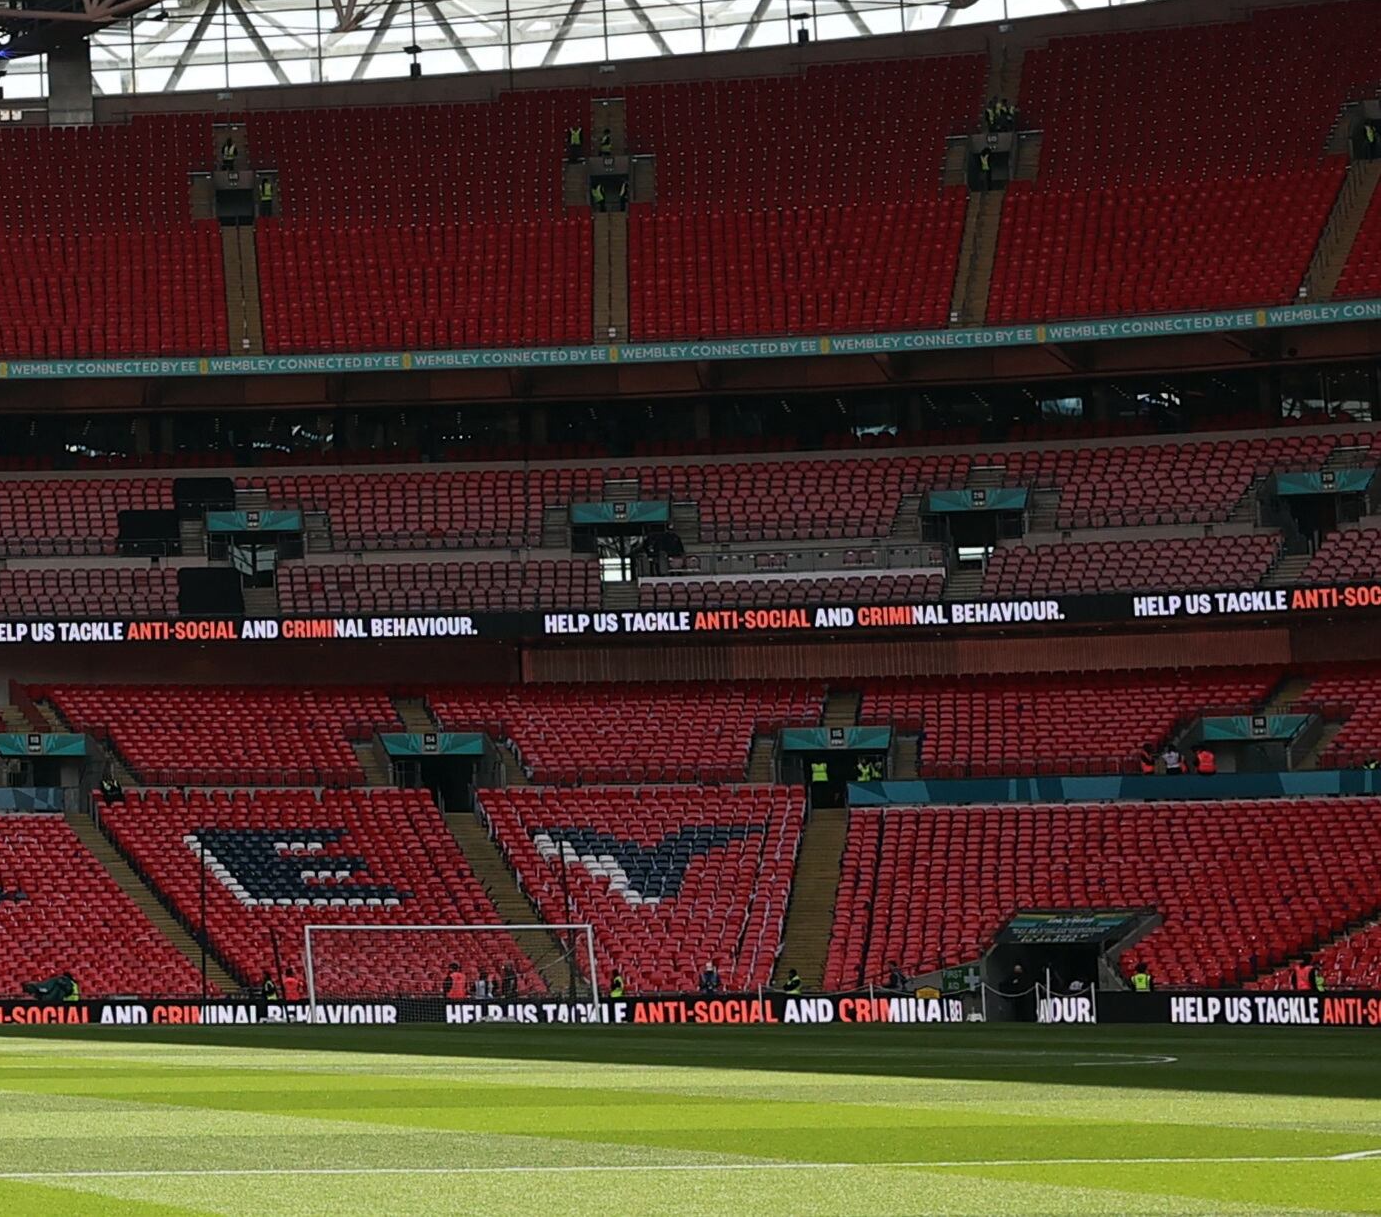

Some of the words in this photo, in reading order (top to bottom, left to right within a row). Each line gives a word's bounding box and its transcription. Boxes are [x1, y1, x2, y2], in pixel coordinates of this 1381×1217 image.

[1050, 323, 1116, 339] WEMBLEY
[1122, 317, 1212, 334] CONNECTED
[1215, 315, 1233, 327] BY
[1237, 314, 1252, 325] EE
[833, 337, 899, 350] WEMBLEY
[905, 332, 993, 346] CONNECTED
[995, 330, 1013, 342] BY
[1017, 329, 1032, 341] EE
[1134, 596, 1181, 616] HELP
[1186, 594, 1211, 614] US
[1215, 591, 1287, 612] TACKLE
[31, 623, 54, 641] US
[58, 622, 123, 641] TACKLE
[128, 622, 237, 639] ANTI-SOCIAL
[242, 621, 278, 638] AND
[282, 620, 367, 638] CRIMINAL
[371, 617, 477, 636] BEHAVIOUR.
[545, 614, 589, 633] HELP
[594, 613, 618, 632] US
[622, 611, 690, 632] TACKLE
[695, 609, 810, 629] ANTI-SOCIAL
[815, 607, 853, 627] AND
[858, 605, 948, 626] CRIMINAL
[952, 601, 1064, 623] BEHAVIOUR.
[101, 1006, 147, 1023] AND
[446, 1005, 503, 1023] HELP
[509, 1005, 538, 1023] US
[635, 1001, 777, 1022] ANTI-SOCIAL
[785, 998, 833, 1022] AND
[1171, 997, 1220, 1022] HELP
[1225, 998, 1251, 1022] US
[1255, 998, 1319, 1023] TACKLE
